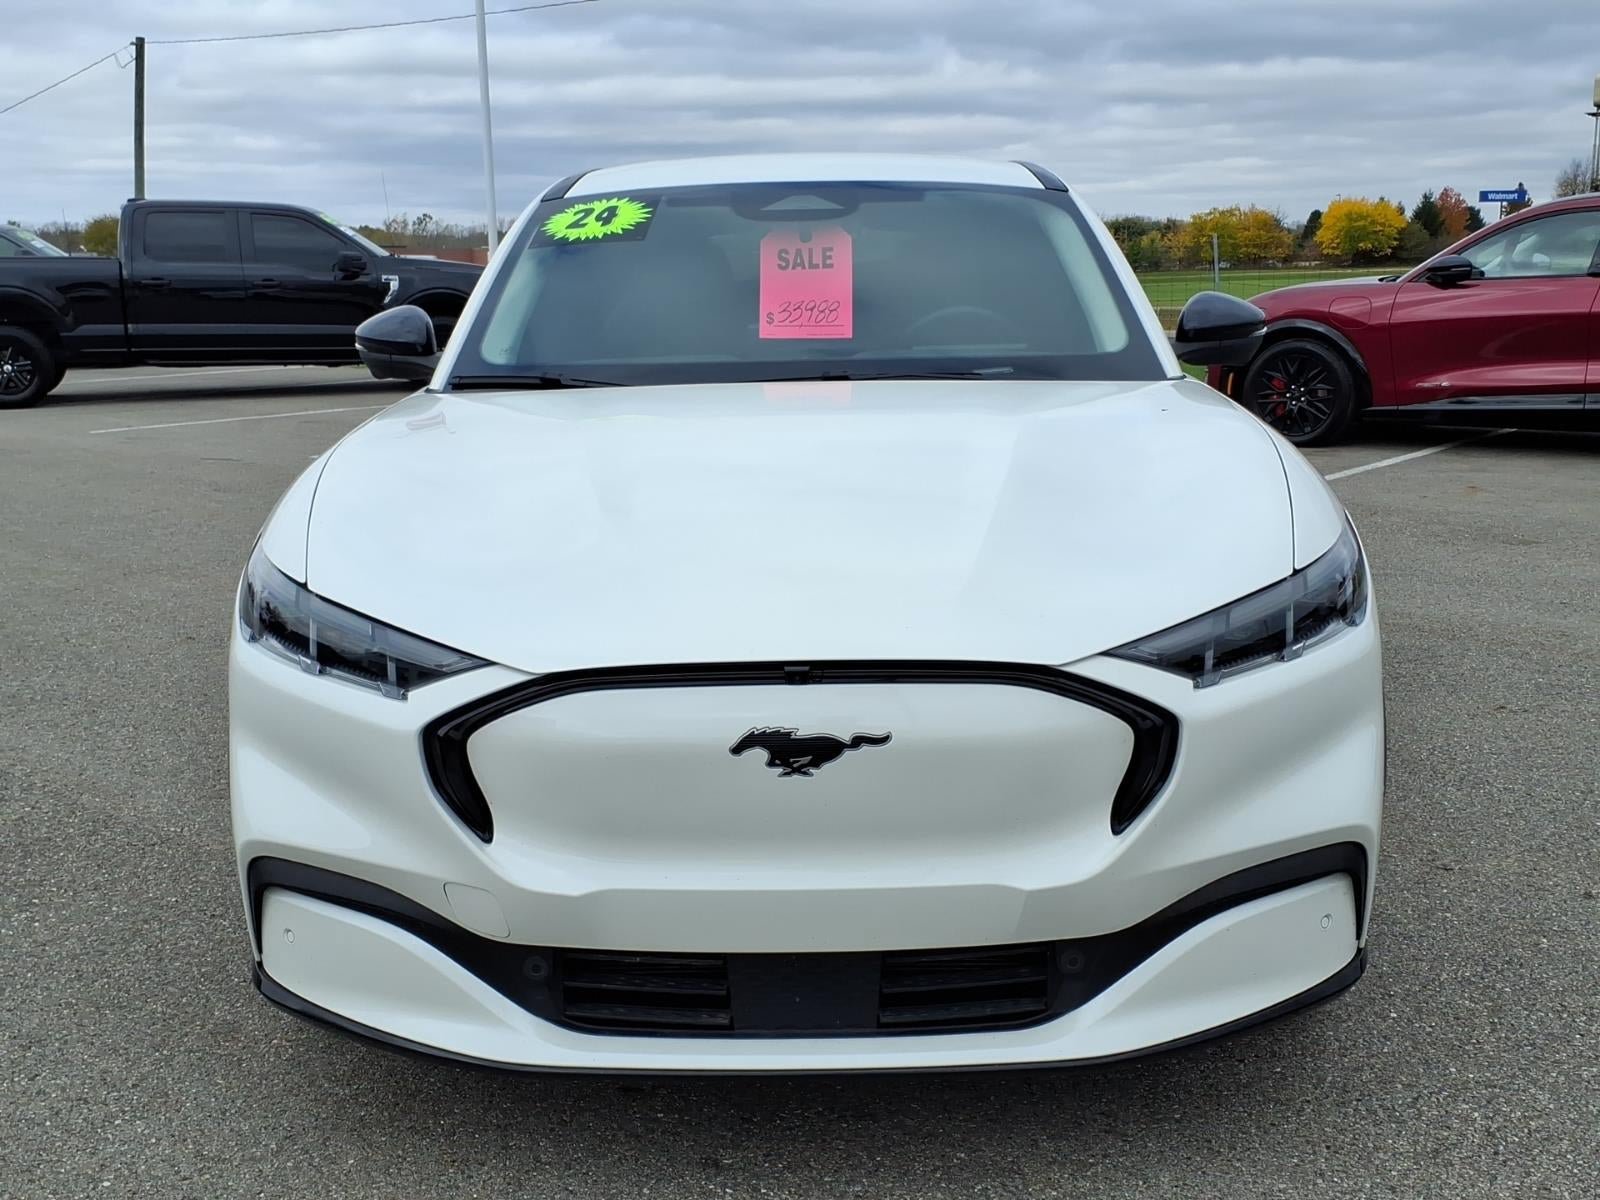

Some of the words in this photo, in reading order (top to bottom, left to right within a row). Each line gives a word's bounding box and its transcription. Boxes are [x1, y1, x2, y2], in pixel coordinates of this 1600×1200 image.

[1487, 192, 1518, 200] Walmart
[565, 205, 619, 230] 24
[777, 246, 834, 271] SALE
